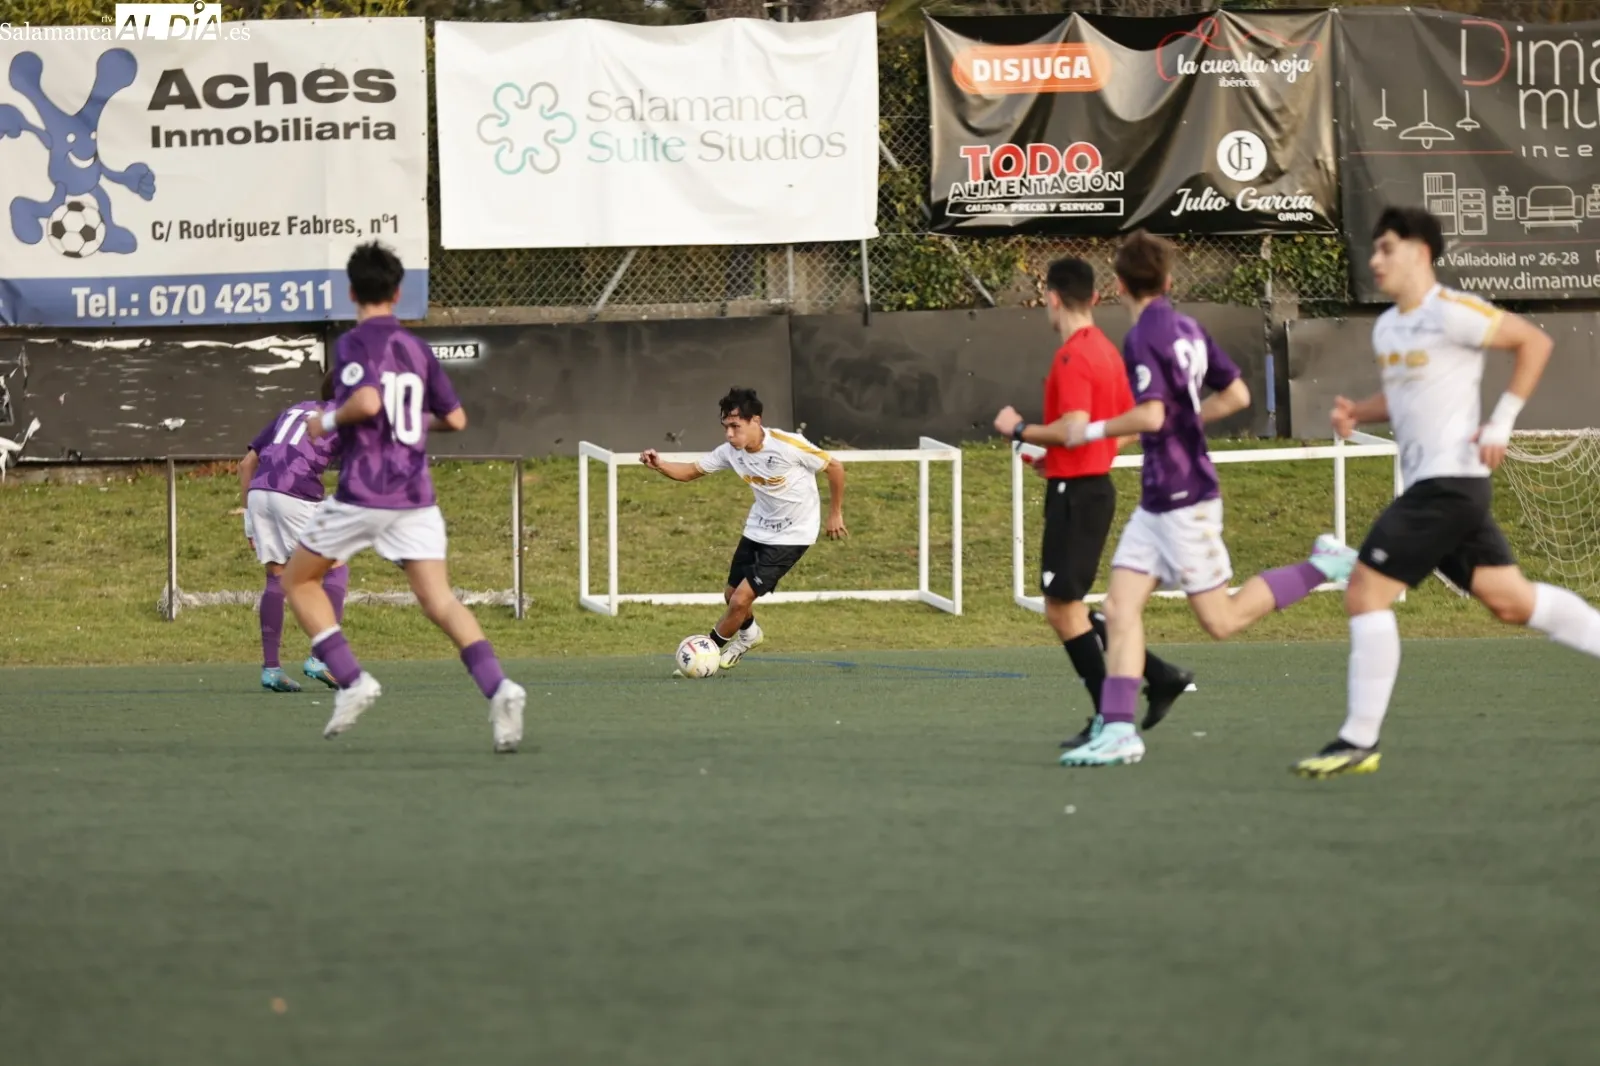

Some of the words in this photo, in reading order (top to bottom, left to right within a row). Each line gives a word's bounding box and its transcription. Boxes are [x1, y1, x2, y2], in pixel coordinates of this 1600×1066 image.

[972, 56, 1092, 82] DISJUGA
[1177, 54, 1199, 75] la
[1200, 52, 1268, 73] cuerda
[1271, 53, 1313, 83] roja
[147, 62, 397, 111] Aches
[585, 89, 808, 123] Salamanca
[151, 116, 396, 148] Inmobiliaria
[586, 130, 687, 163] Suite
[697, 127, 847, 162] Studios
[960, 141, 1102, 183] TODO
[949, 170, 1124, 201] ALIMENTACIÓN
[1170, 186, 1230, 216] Julio
[1235, 187, 1315, 212] García
[1010, 203, 1048, 213] PRECIO
[1059, 203, 1105, 212] SERVICIO
[1277, 212, 1314, 222] GRUPO
[151, 221, 172, 242] C/
[179, 219, 281, 242] Rodriguez
[287, 215, 362, 237] Fabres,
[1448, 252, 1516, 267] Valladolid
[1539, 251, 1580, 266] 26-28
[72, 287, 139, 318] Tel.:
[149, 284, 206, 317] 670
[214, 282, 272, 315] 425
[280, 279, 334, 312] 311
[381, 371, 424, 446] 10
